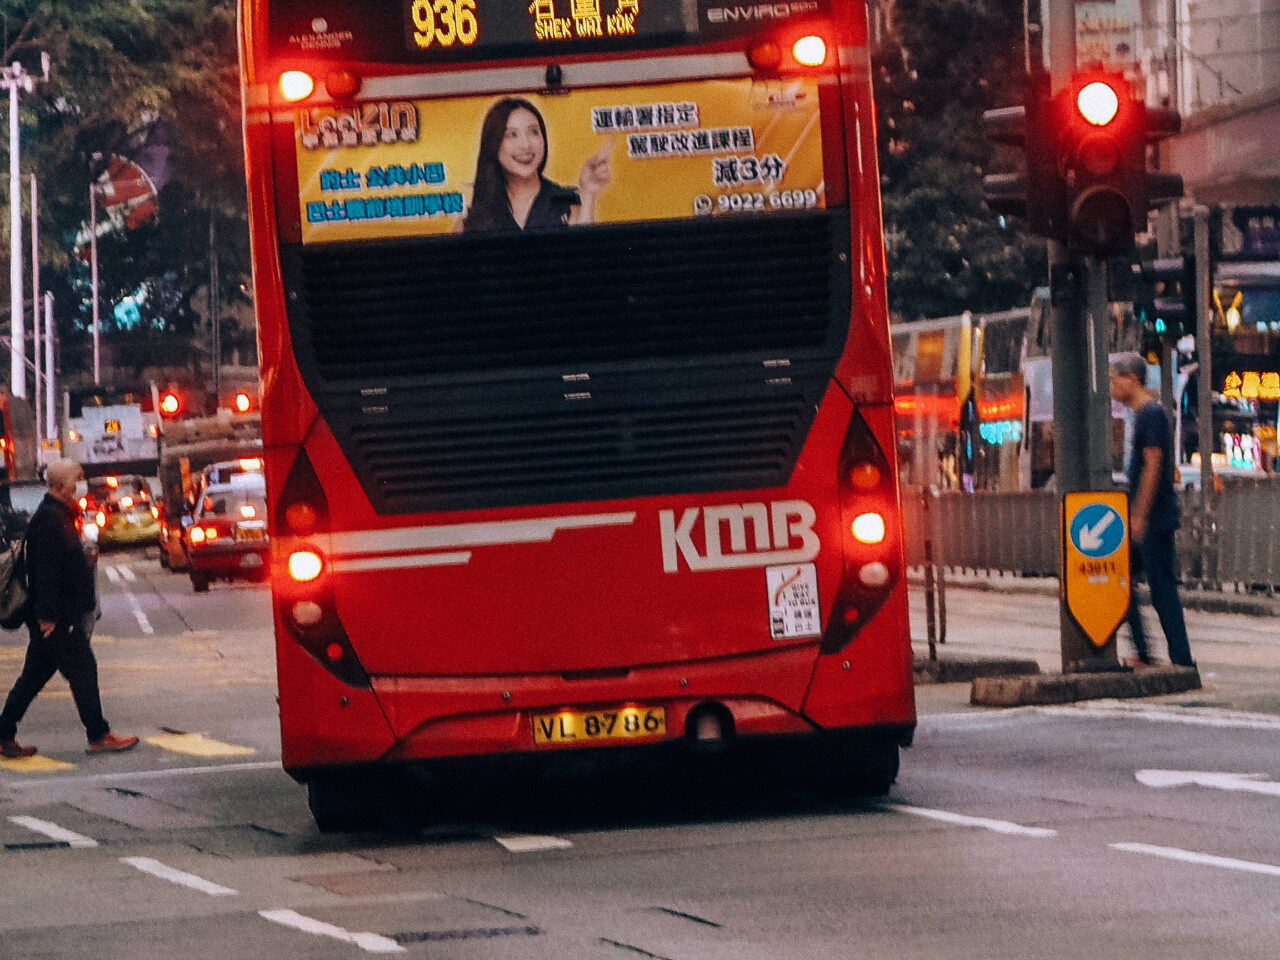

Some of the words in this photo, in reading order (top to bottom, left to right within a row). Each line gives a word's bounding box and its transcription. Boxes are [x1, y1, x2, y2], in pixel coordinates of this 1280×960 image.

[534, 16, 572, 40] SHEK
[575, 15, 603, 38] WAI
[606, 12, 637, 36] KOK
[714, 155, 785, 185] 減3分
[717, 192, 765, 211] 9022
[769, 189, 817, 209] 6699
[658, 500, 821, 573] KMB
[540, 716, 576, 739] VL
[584, 711, 659, 736] 8786
